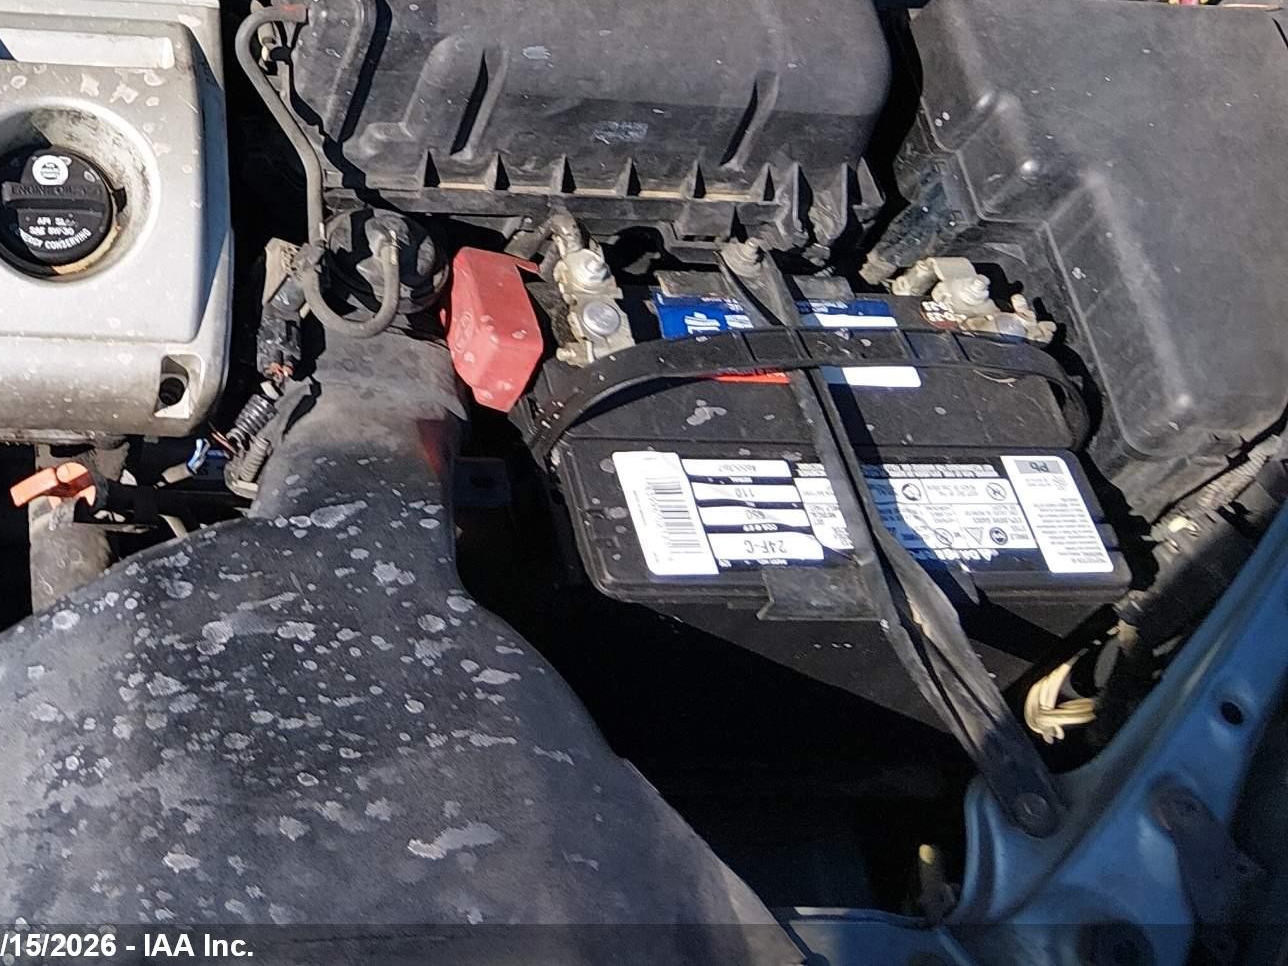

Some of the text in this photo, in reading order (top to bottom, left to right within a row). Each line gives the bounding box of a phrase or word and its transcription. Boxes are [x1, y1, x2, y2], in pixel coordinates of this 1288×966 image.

[29, 226, 46, 236] SAE
[44, 228, 92, 250] CONSERVING
[1030, 461, 1048, 472] Pb
[743, 539, 789, 555] 24F-C
